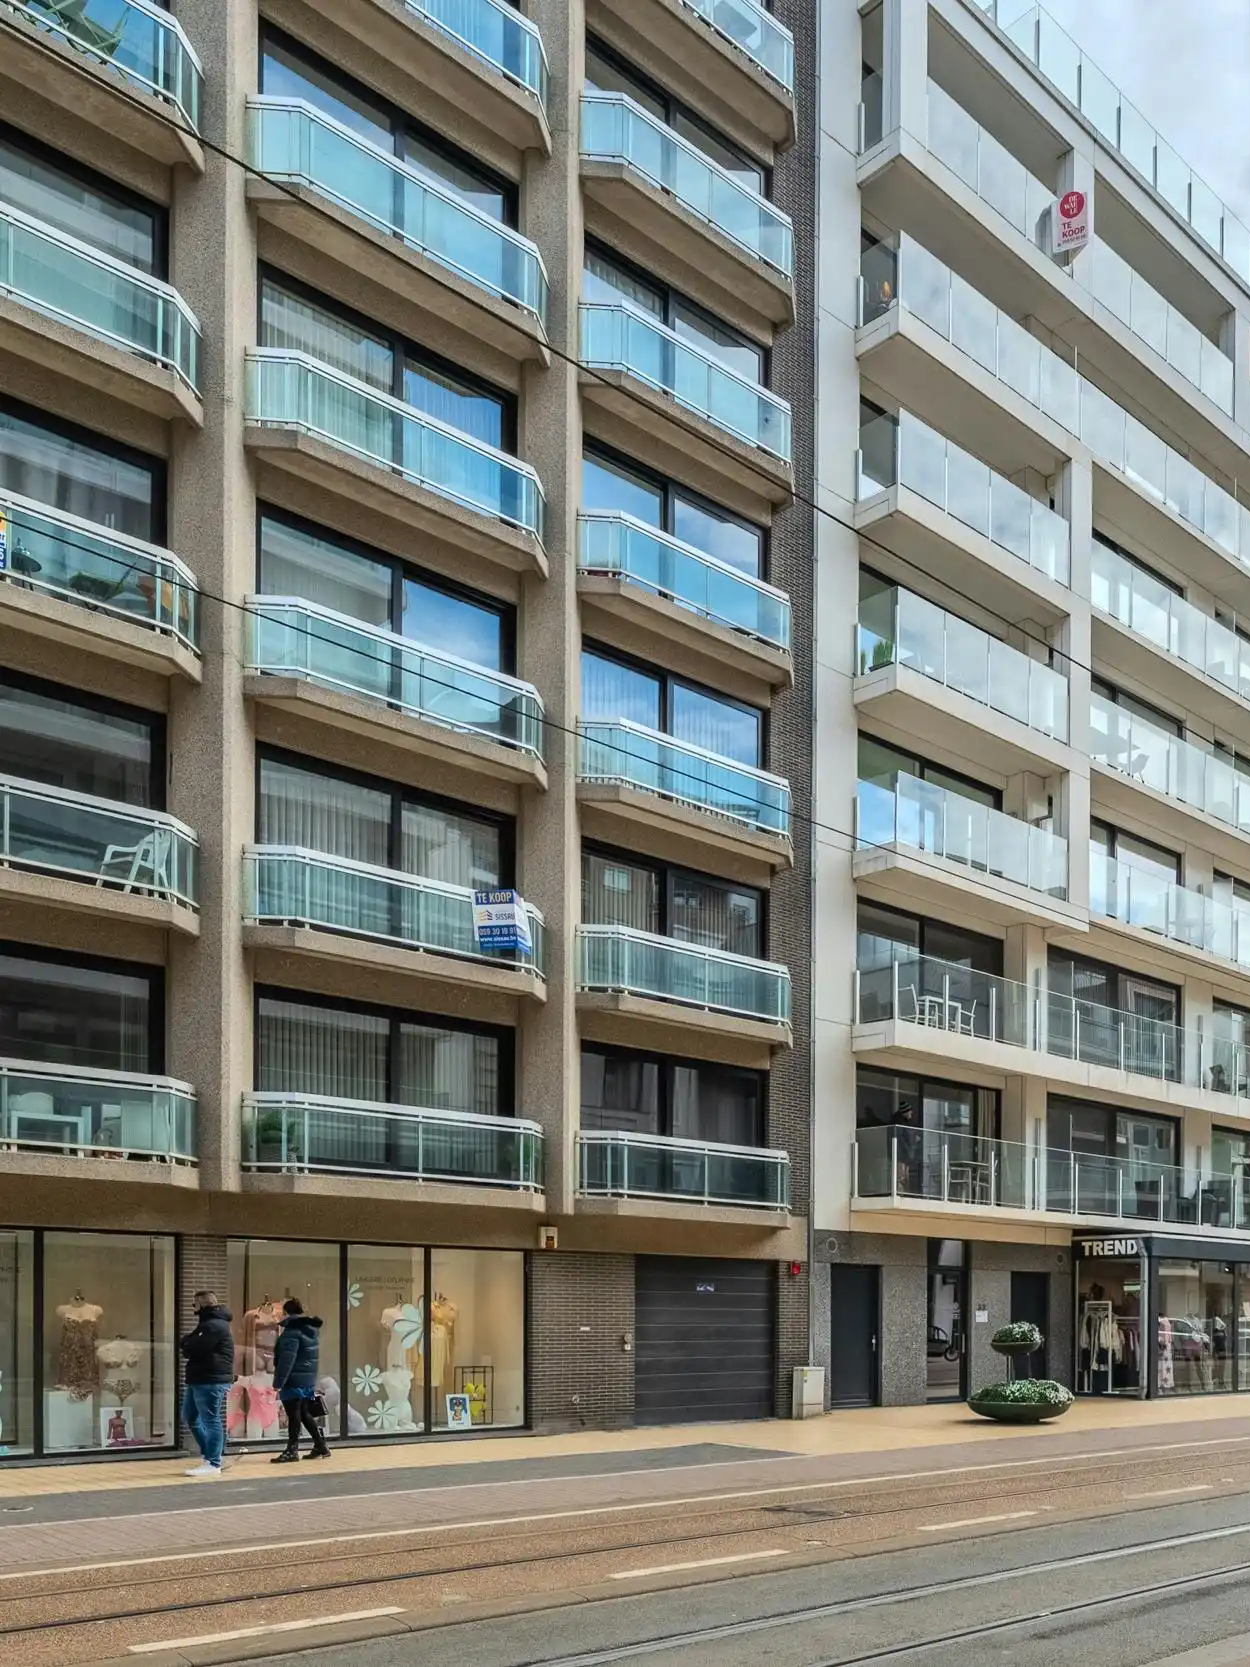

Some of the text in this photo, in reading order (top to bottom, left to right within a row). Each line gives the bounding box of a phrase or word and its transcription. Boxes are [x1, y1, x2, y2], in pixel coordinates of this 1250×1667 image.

[1062, 221, 1072, 230] TE
[1062, 226, 1085, 238] KOOP
[477, 892, 512, 903] TE KOOP
[1081, 1239, 1138, 1257] TREND
